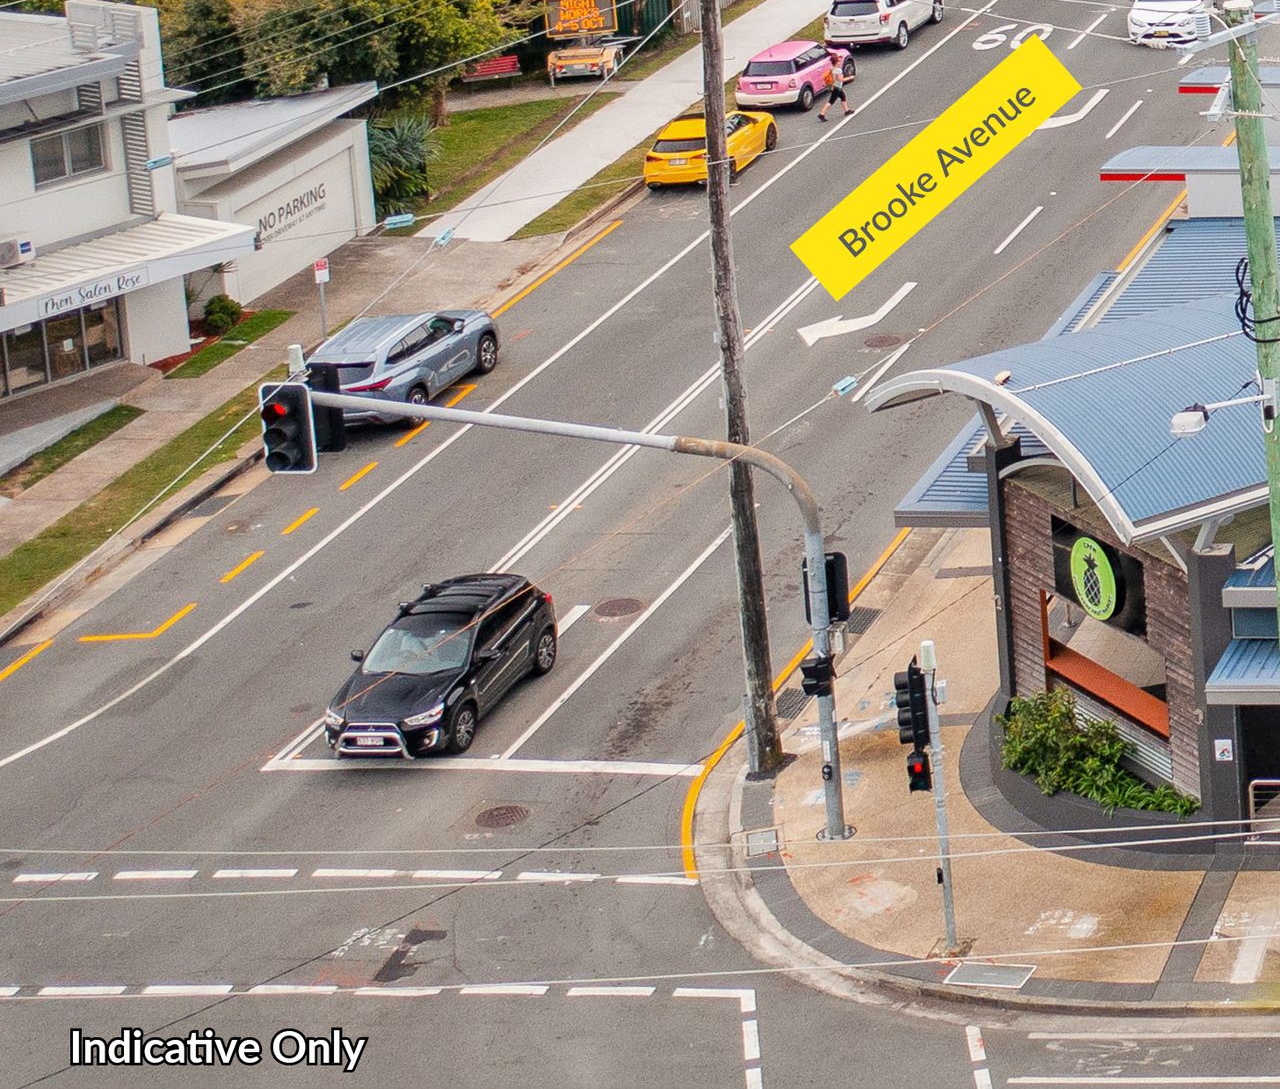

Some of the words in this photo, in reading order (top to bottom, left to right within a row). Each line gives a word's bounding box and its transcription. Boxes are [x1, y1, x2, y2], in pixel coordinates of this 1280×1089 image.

[582, 16, 605, 29] OCT
[258, 212, 276, 232] NO
[278, 183, 326, 224] PARKING
[78, 284, 112, 302] Salon
[117, 273, 142, 292] Rose
